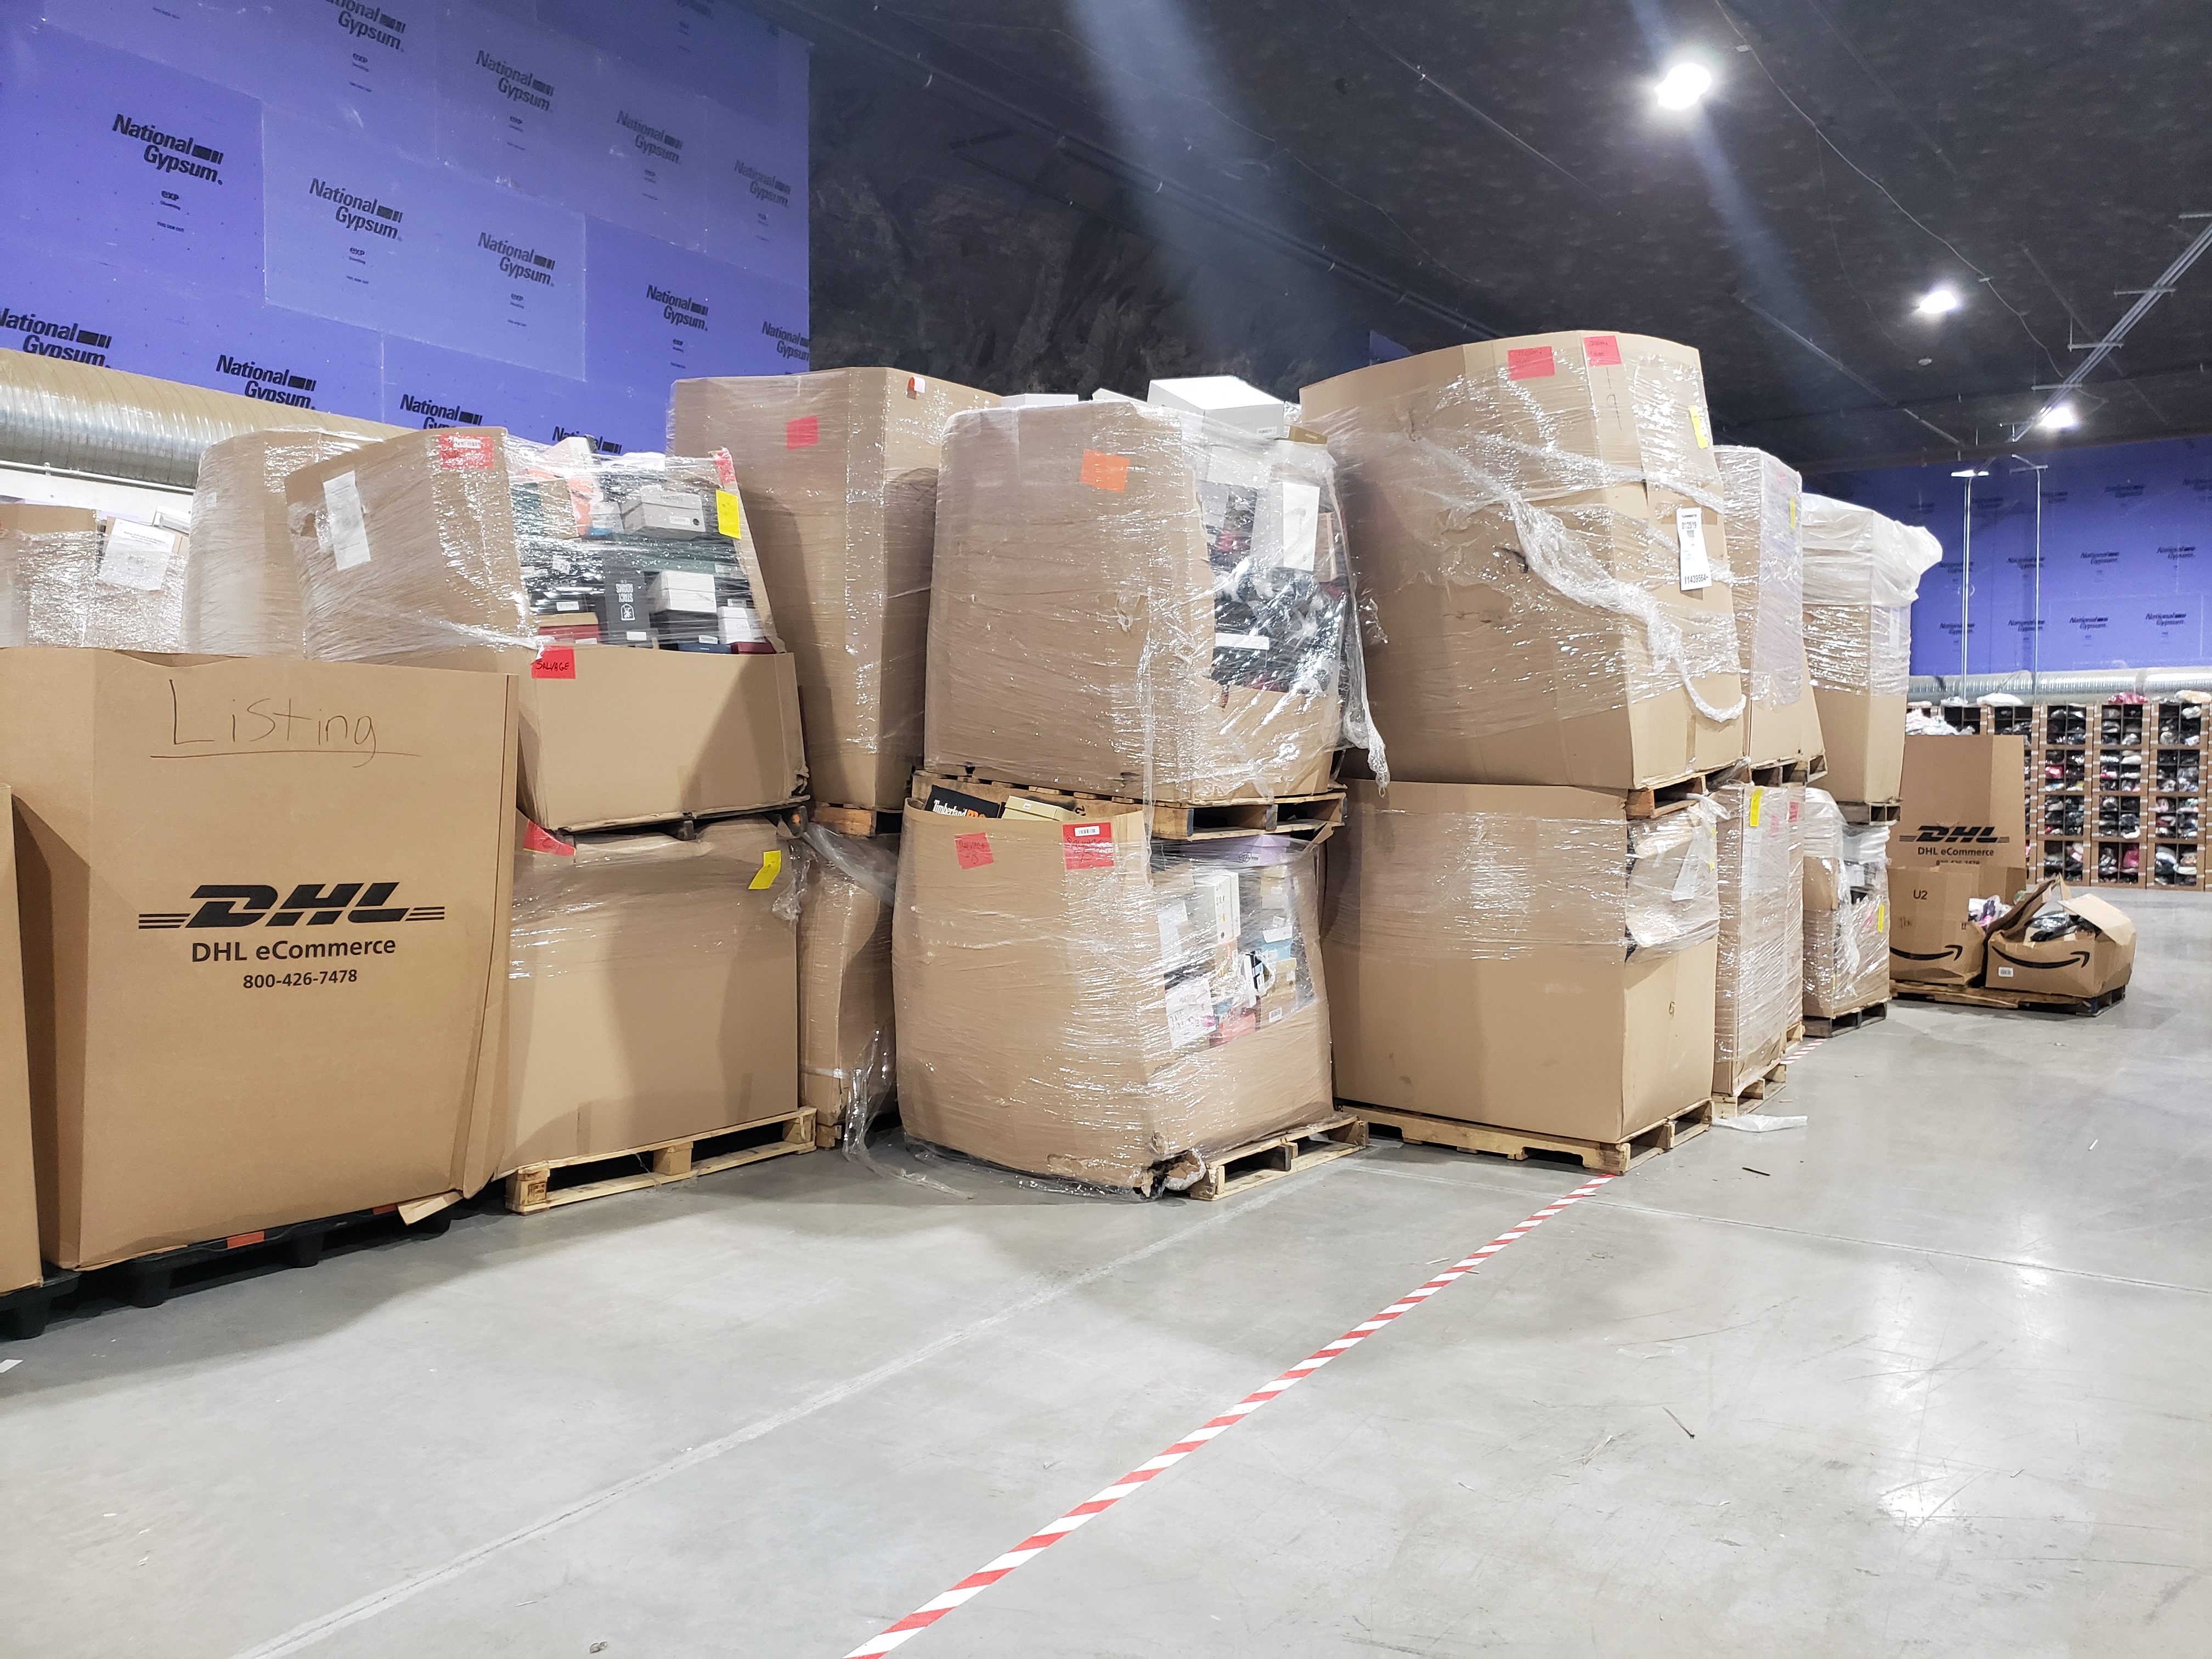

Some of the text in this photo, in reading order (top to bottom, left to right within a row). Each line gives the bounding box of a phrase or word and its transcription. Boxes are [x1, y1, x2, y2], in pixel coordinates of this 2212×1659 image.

[326, 0, 380, 21] ional
[476, 50, 533, 86] National
[112, 114, 194, 154] National
[617, 111, 665, 142] National
[309, 178, 377, 214] National
[478, 232, 534, 263] National
[646, 284, 692, 311] National
[762, 321, 800, 345] National
[216, 354, 290, 386] National
[400, 394, 460, 421] National
[535, 661, 569, 672] SALVAGE
[168, 679, 376, 769] Listing
[933, 799, 967, 816] Timberland
[1916, 826, 1999, 843] DHL
[1917, 847, 1994, 856] DHL eCommerce
[185, 882, 410, 928] DHL
[1913, 890, 1928, 900] U2
[192, 939, 396, 962] DHL eCommerce
[242, 969, 357, 989] 800-426-7478
